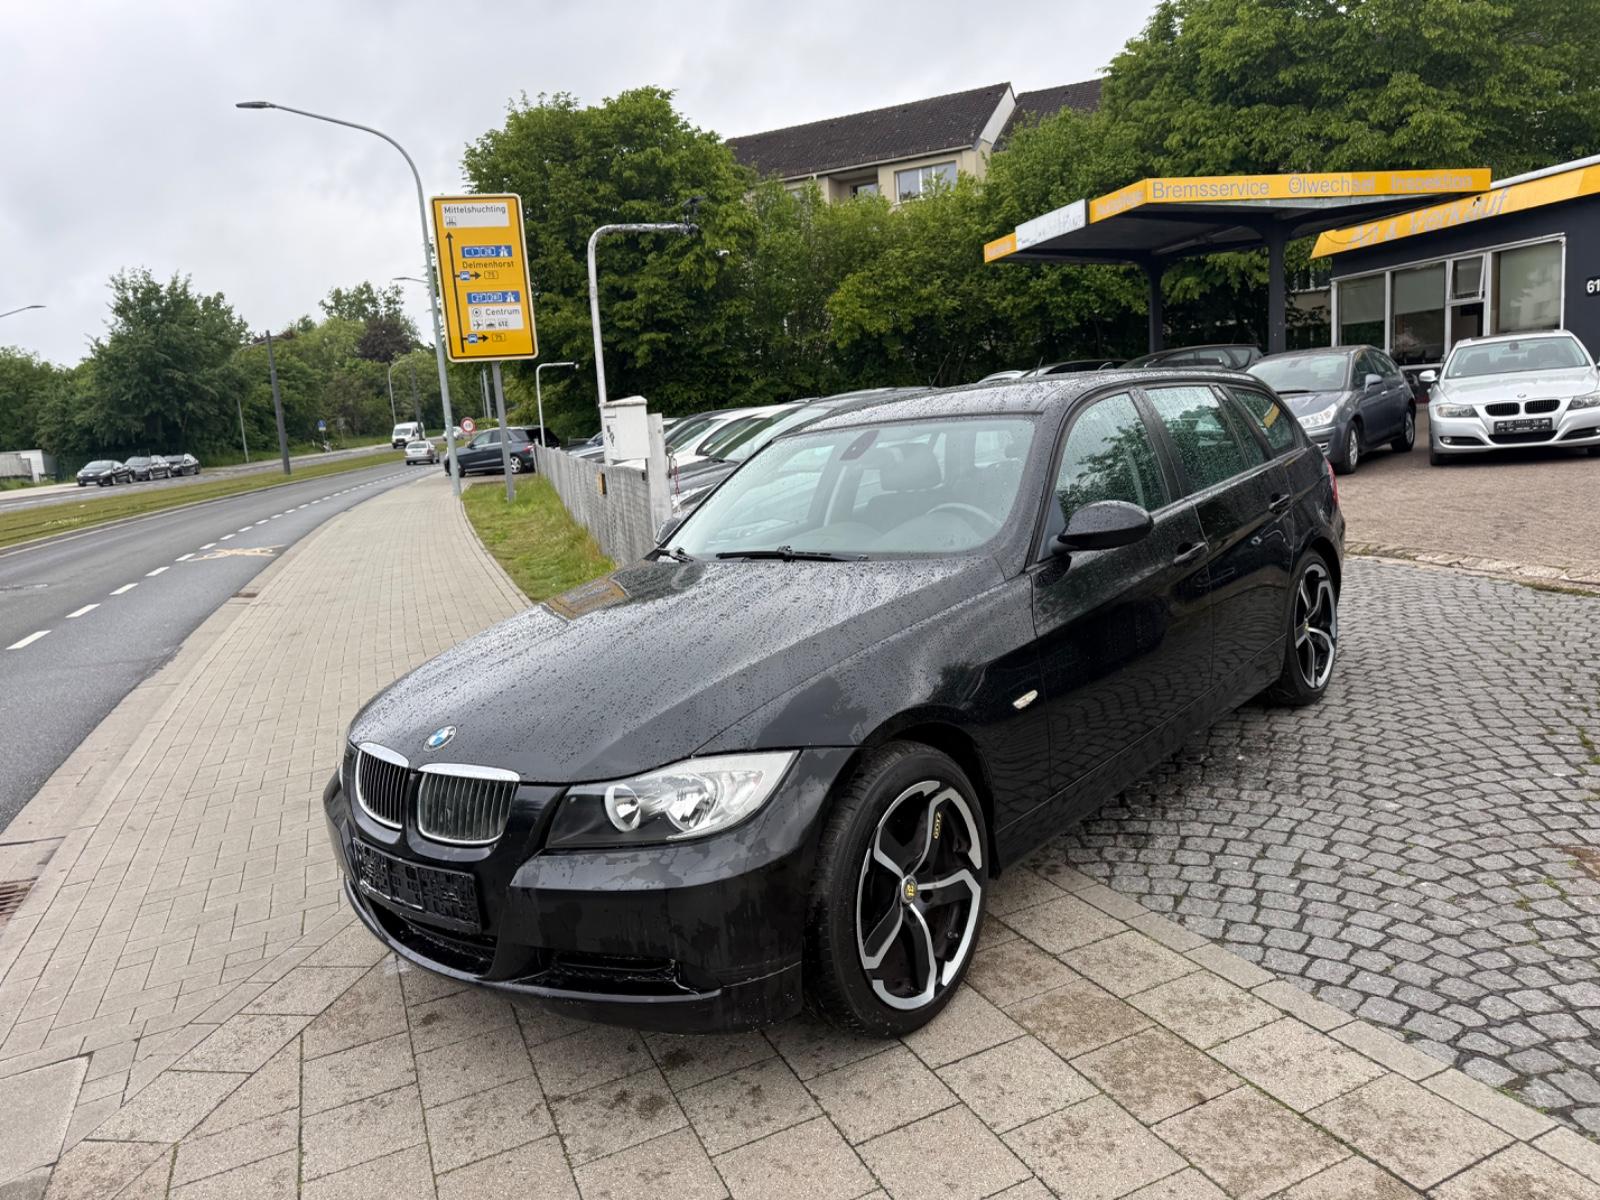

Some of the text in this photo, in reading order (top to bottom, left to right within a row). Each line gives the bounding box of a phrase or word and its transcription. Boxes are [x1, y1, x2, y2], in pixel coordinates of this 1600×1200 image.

[1152, 179, 1269, 199] Bremsservice
[1287, 175, 1376, 194] Ölwechsel
[444, 205, 506, 214] Mittelshuchting
[462, 260, 514, 269] Delmenhorst
[485, 308, 520, 316] Centrum
